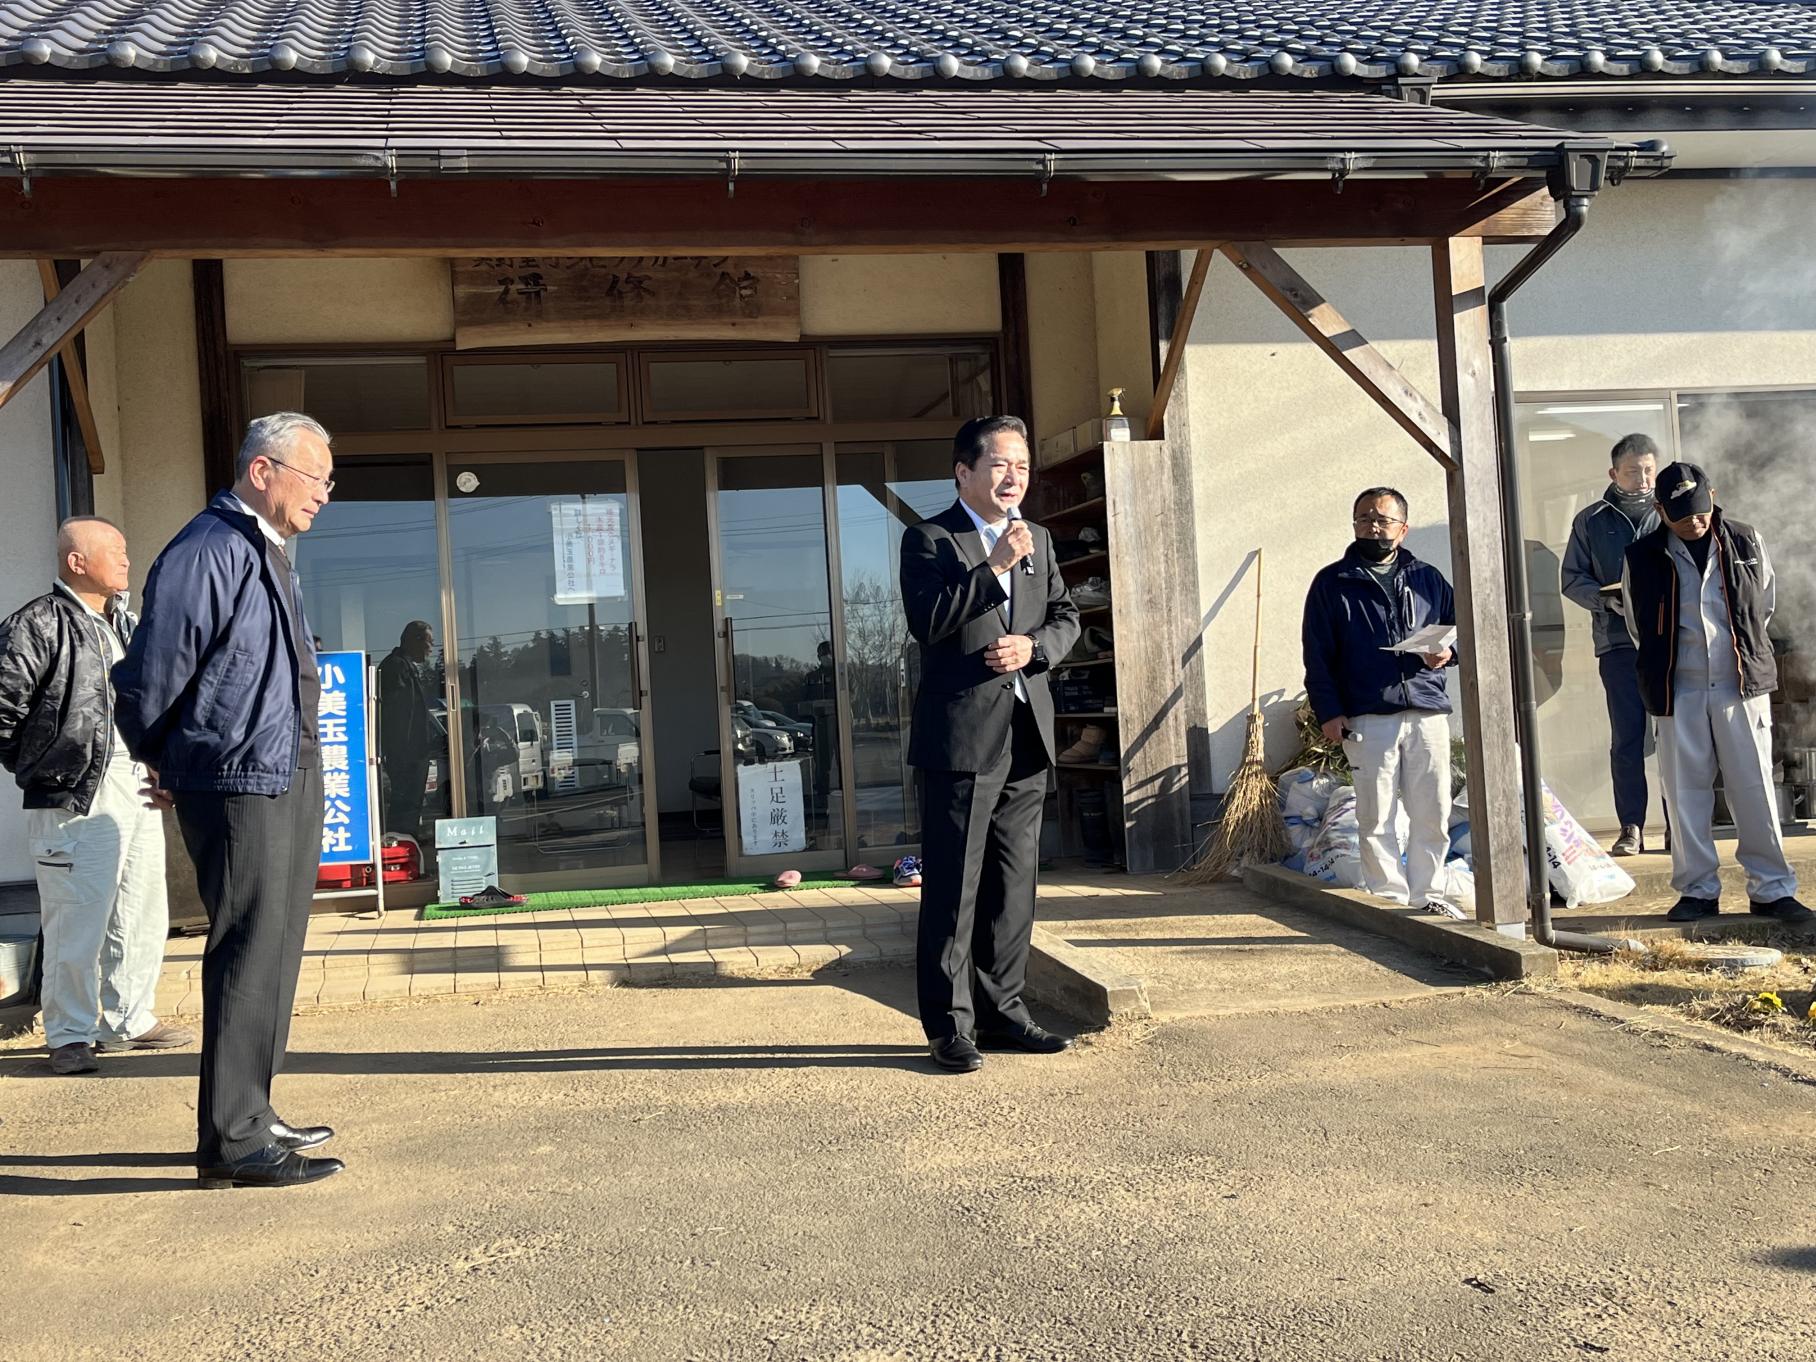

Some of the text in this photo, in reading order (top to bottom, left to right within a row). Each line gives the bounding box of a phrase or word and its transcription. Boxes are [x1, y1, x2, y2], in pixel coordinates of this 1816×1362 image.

[317, 663, 353, 853] 小美玉農業公社
[447, 825, 485, 837] Mail
[767, 764, 790, 848] 土足厳禁
